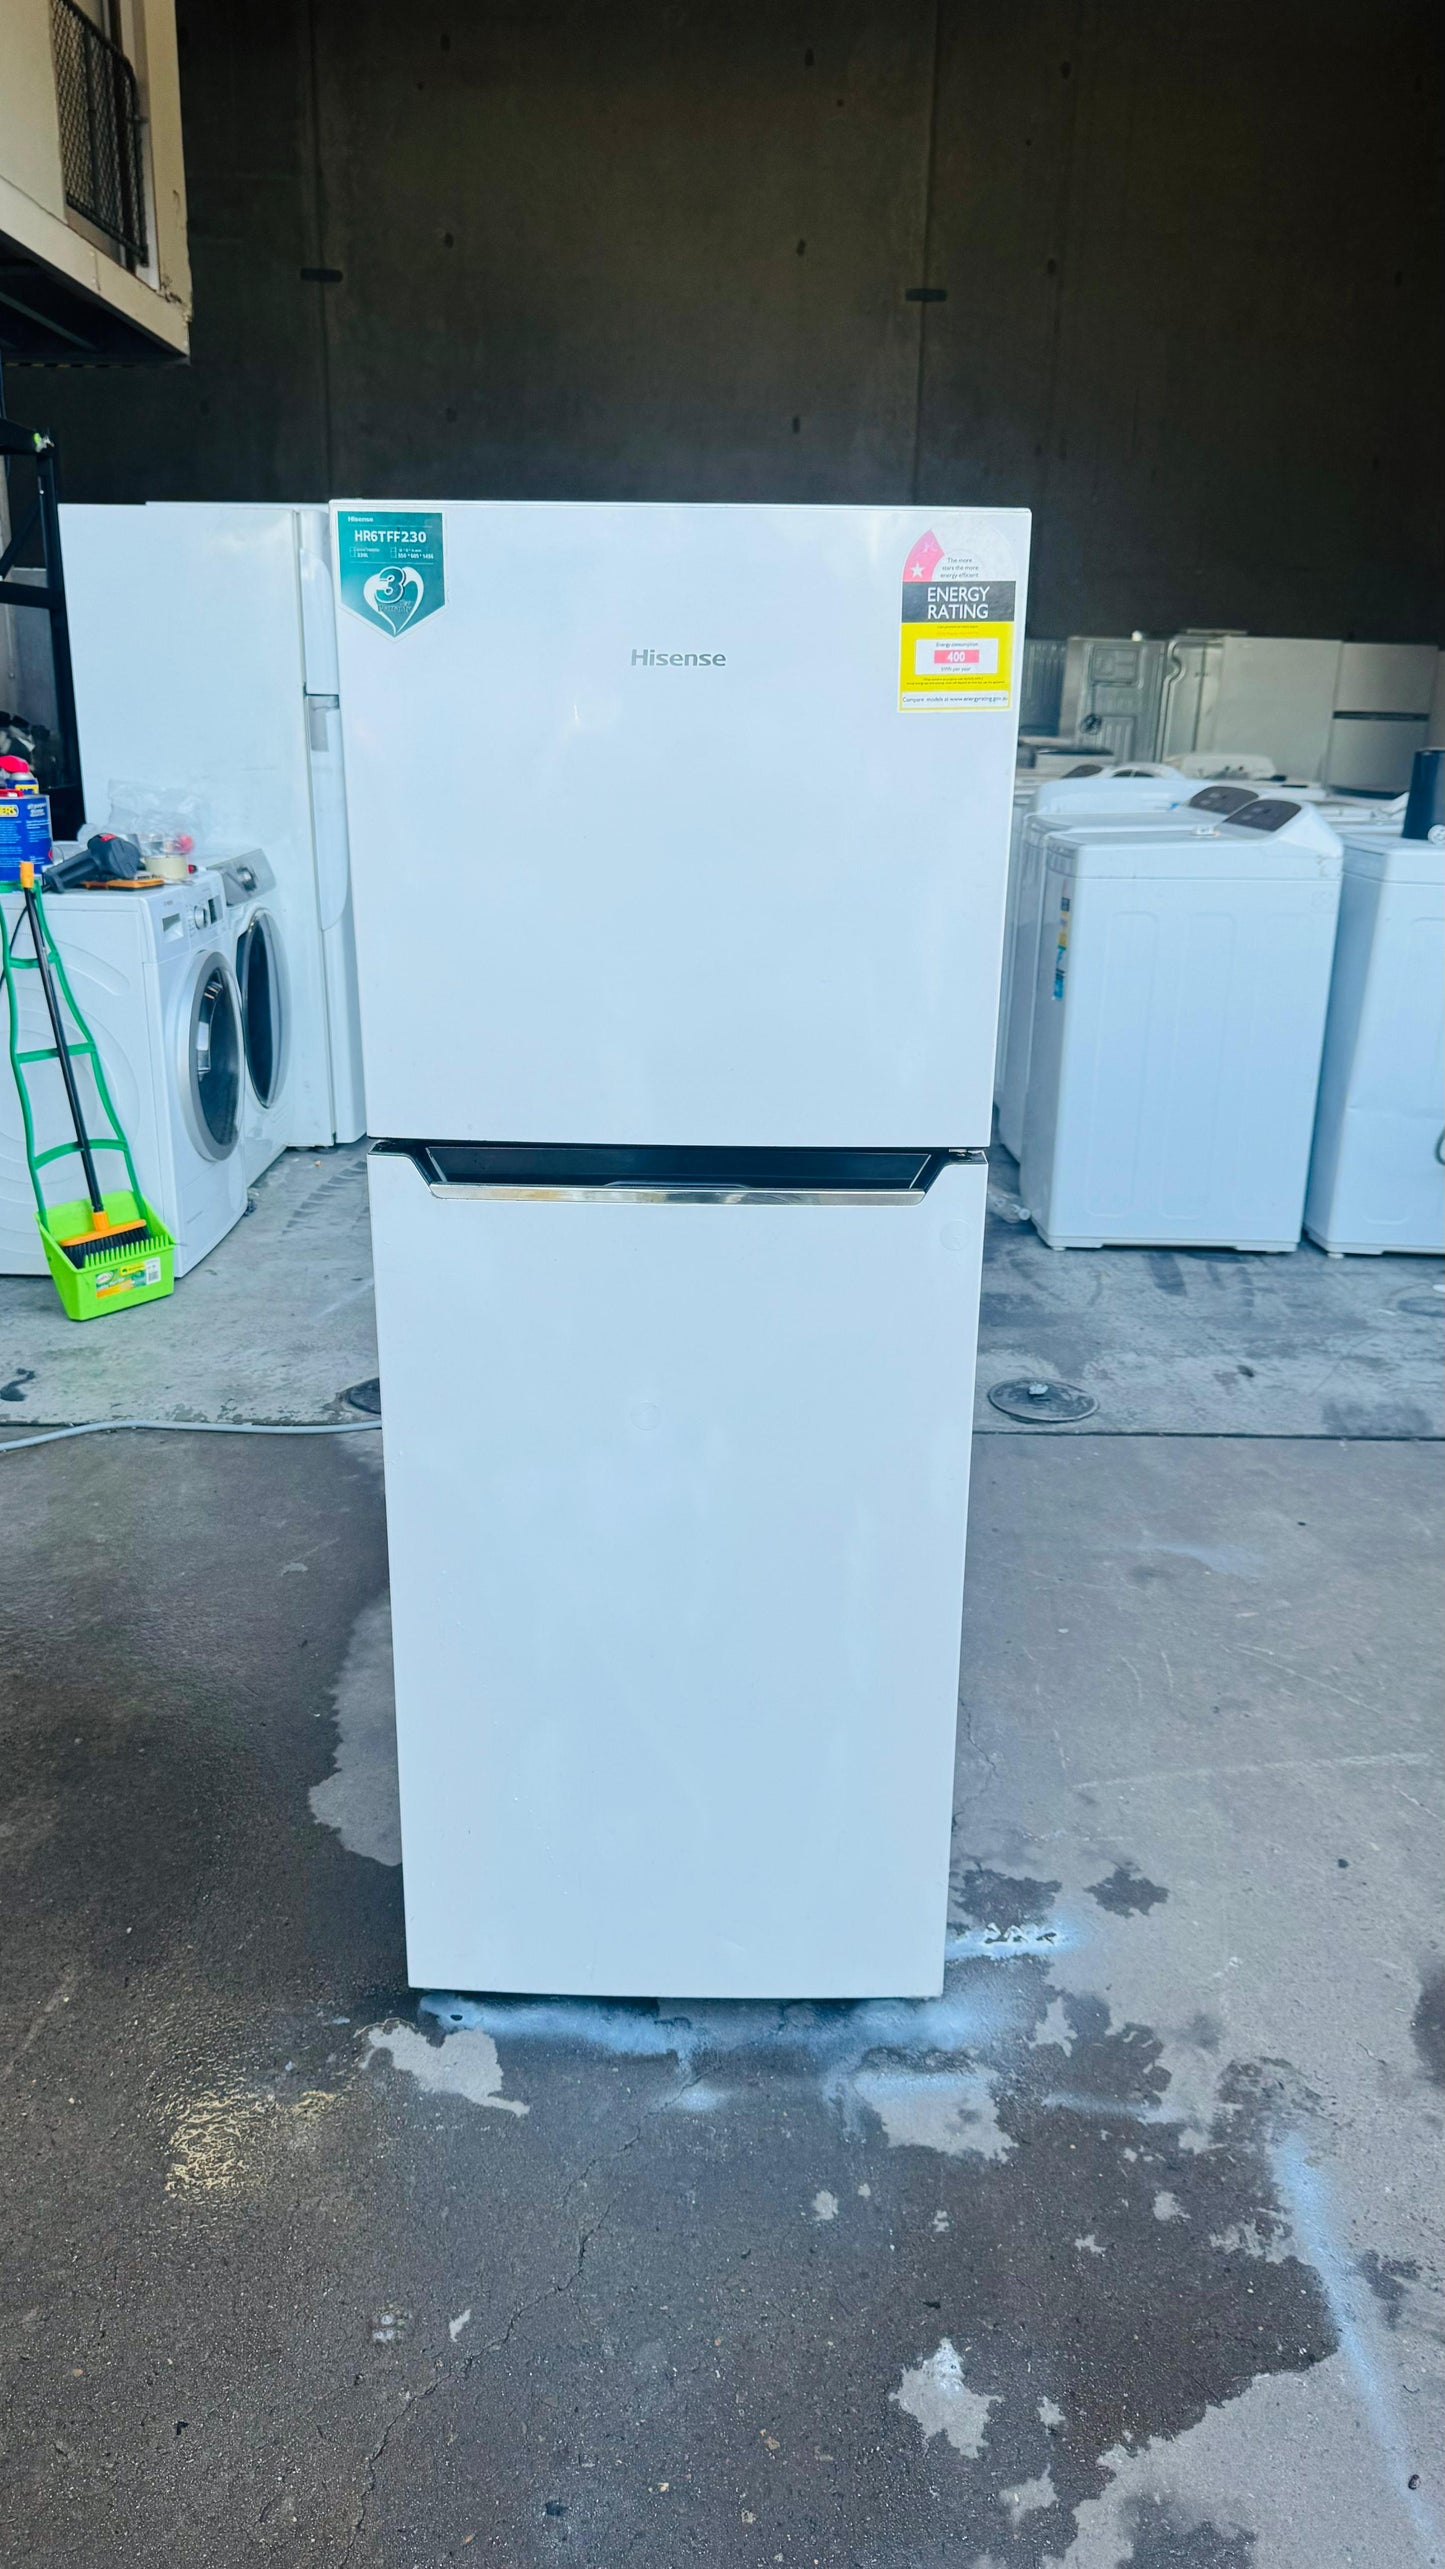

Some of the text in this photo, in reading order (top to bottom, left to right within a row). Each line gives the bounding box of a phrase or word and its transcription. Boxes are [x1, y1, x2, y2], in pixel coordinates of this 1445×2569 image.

[354, 530, 427, 543] HR6TFF230
[374, 566, 405, 604] 3
[927, 586, 990, 602] ENERGY
[928, 604, 989, 619] RATING
[631, 649, 726, 666] Hisense
[947, 651, 965, 662] 400
